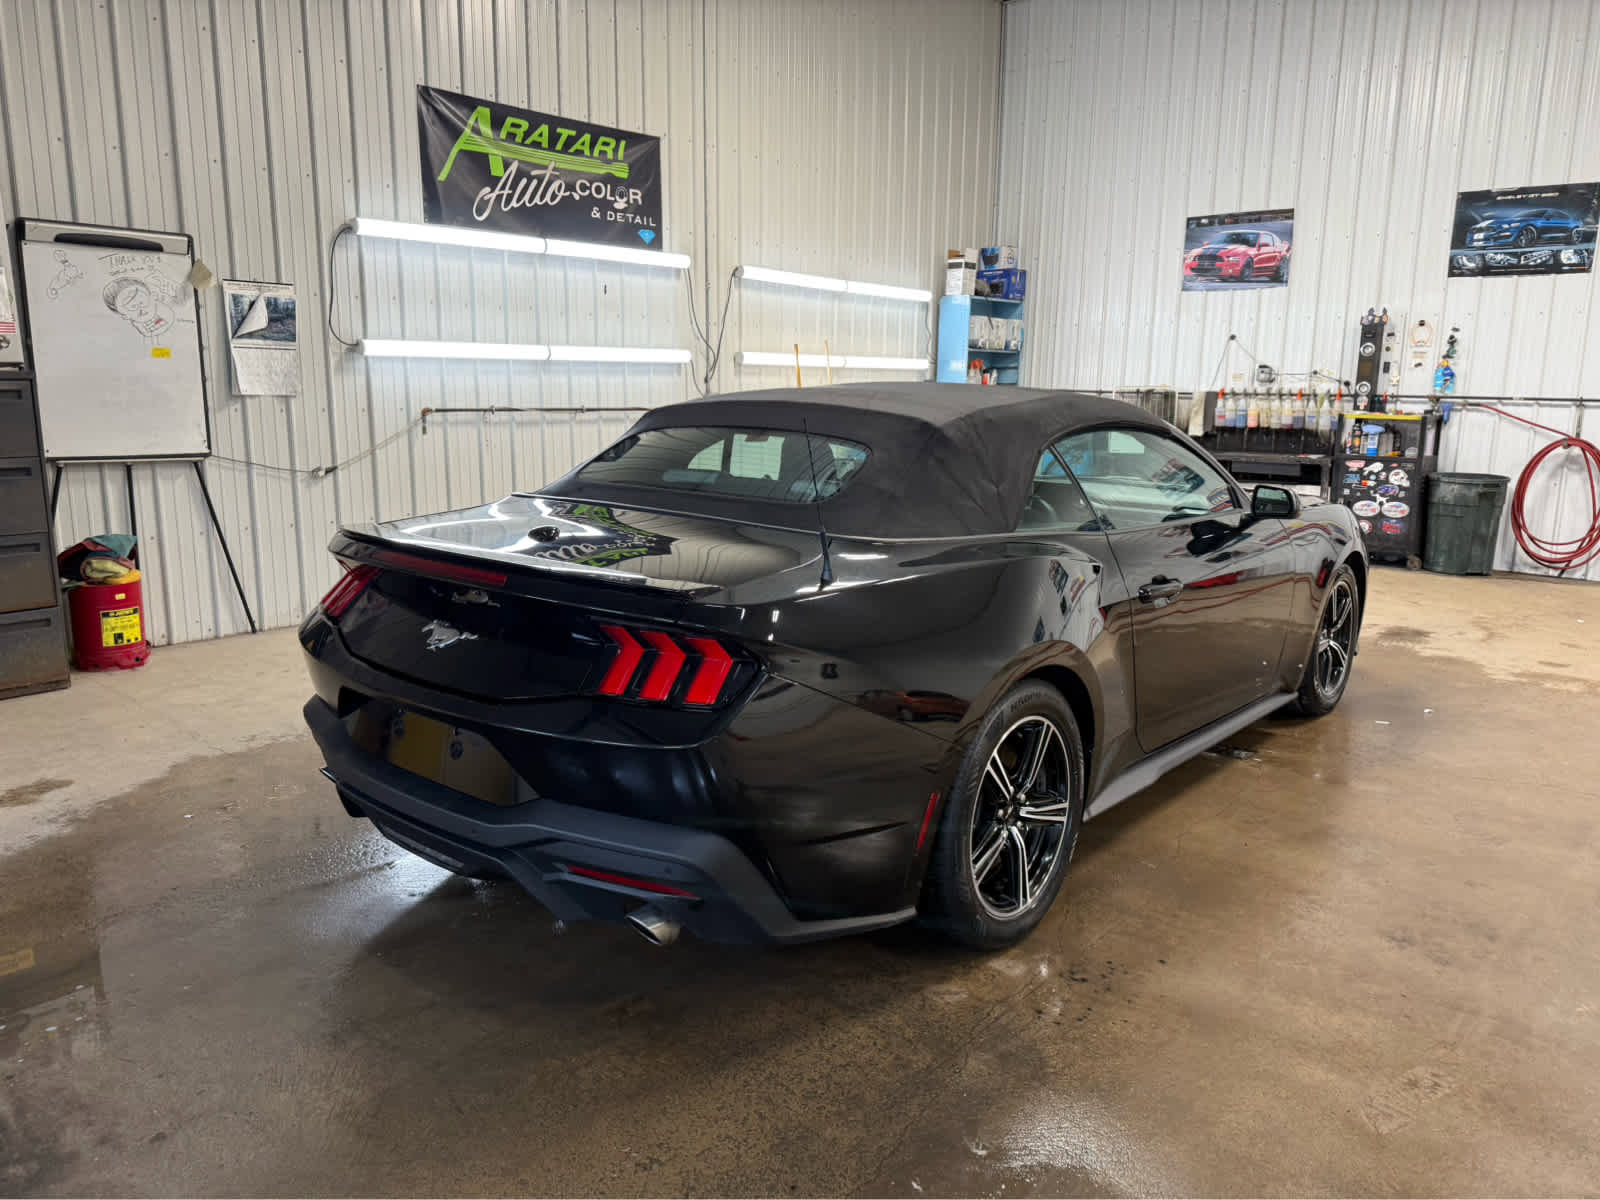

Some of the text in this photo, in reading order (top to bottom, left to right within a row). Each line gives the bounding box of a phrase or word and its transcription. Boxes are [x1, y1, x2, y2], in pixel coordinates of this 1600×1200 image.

[437, 106, 628, 182] ARATARI
[473, 160, 643, 222] Auto COLOR
[591, 207, 657, 226] & DETAIL
